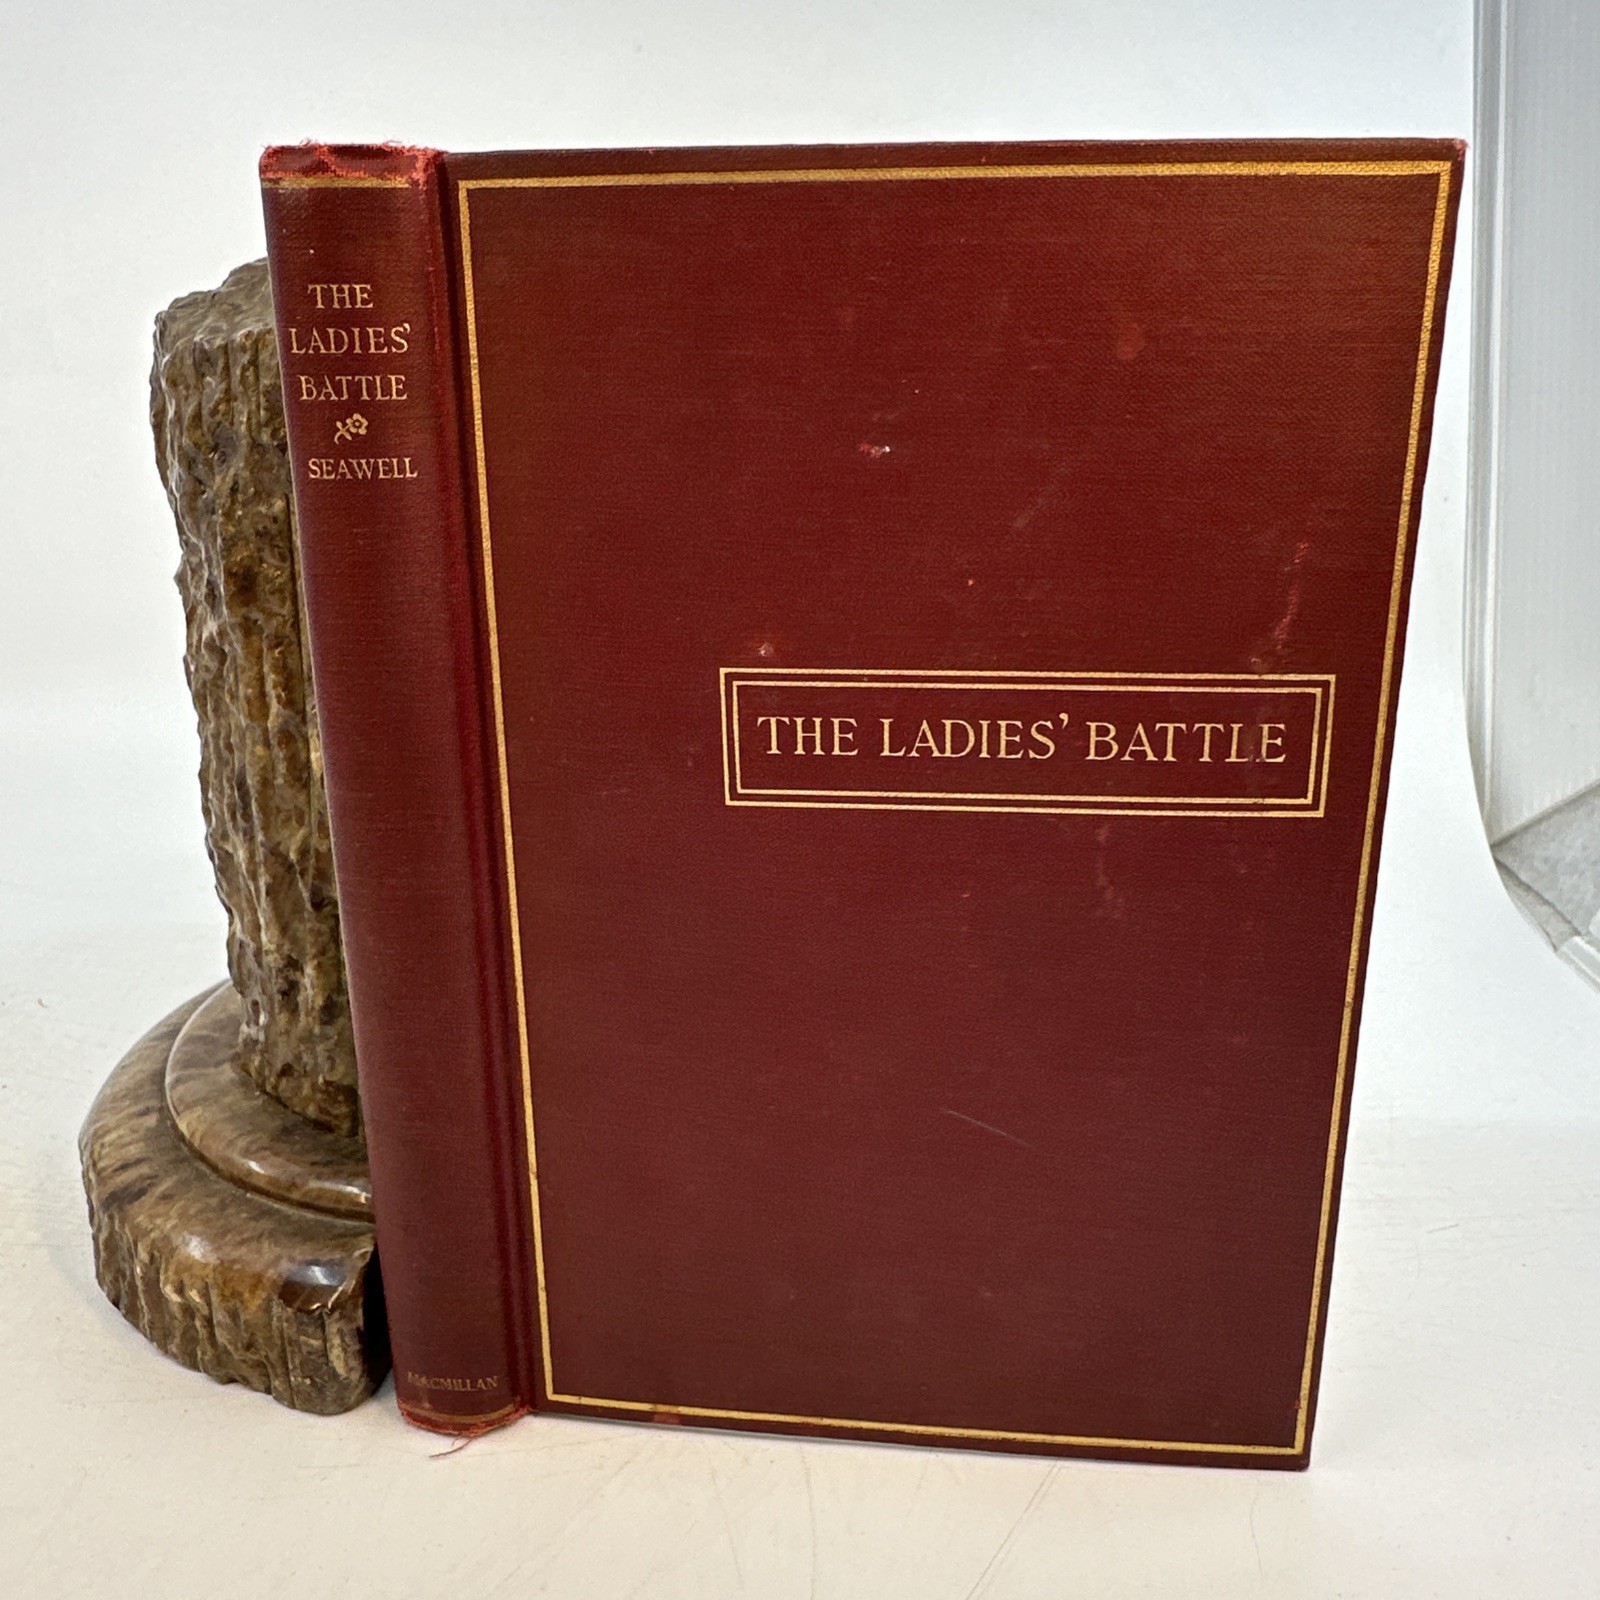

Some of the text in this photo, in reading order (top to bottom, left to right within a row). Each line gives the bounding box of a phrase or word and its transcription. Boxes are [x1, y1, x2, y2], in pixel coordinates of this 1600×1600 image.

[307, 283, 374, 309] THE
[288, 322, 411, 354] LADIES'
[298, 374, 408, 401] BATTLE
[307, 456, 418, 480] SEAWELL
[756, 711, 1288, 764] THE LADIES' BATTLE
